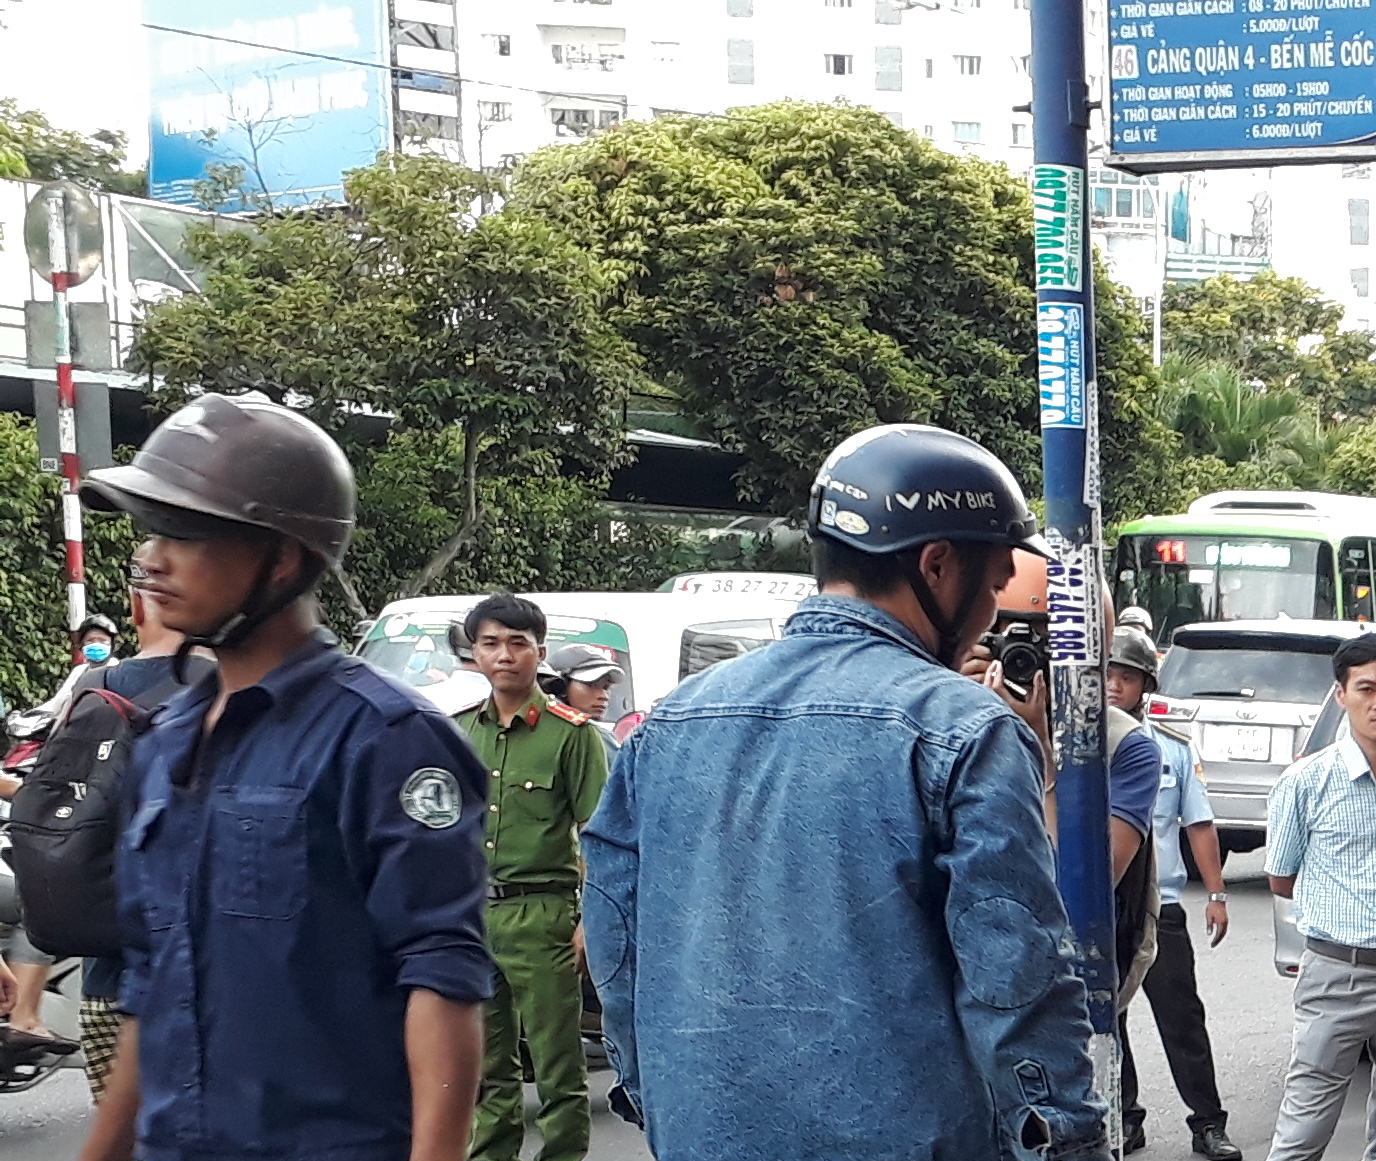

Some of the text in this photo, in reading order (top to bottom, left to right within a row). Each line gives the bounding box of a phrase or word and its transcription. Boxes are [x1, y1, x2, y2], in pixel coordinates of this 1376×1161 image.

[1148, 2, 1174, 17] GIAN
[1114, 47, 1134, 76] 46
[1147, 39, 1191, 75] CẢNG
[1194, 39, 1240, 77] QUẬN
[1243, 45, 1255, 70] 4
[1270, 34, 1305, 69] BẾN
[1340, 30, 1375, 67] CỐC
[1121, 85, 1146, 101] THỜI
[1148, 86, 1172, 100] GIAN
[1174, 85, 1201, 102] HOẠT
[1204, 81, 1234, 100] ĐỘNG
[1252, 83, 1286, 98] 05H00
[1296, 81, 1330, 96] 19H00
[1122, 105, 1149, 122] THỜI
[1151, 107, 1177, 121] GIAN
[1207, 102, 1237, 119] CÁCH
[1252, 103, 1266, 118] 15
[1276, 103, 1291, 117] 20
[1123, 126, 1141, 143] GIÁ
[926, 490, 961, 512] MY
[965, 491, 996, 510] BIKE
[1156, 540, 1186, 563] 11
[711, 579, 733, 593] 38
[741, 579, 762, 593] 27
[767, 581, 789, 595] 27
